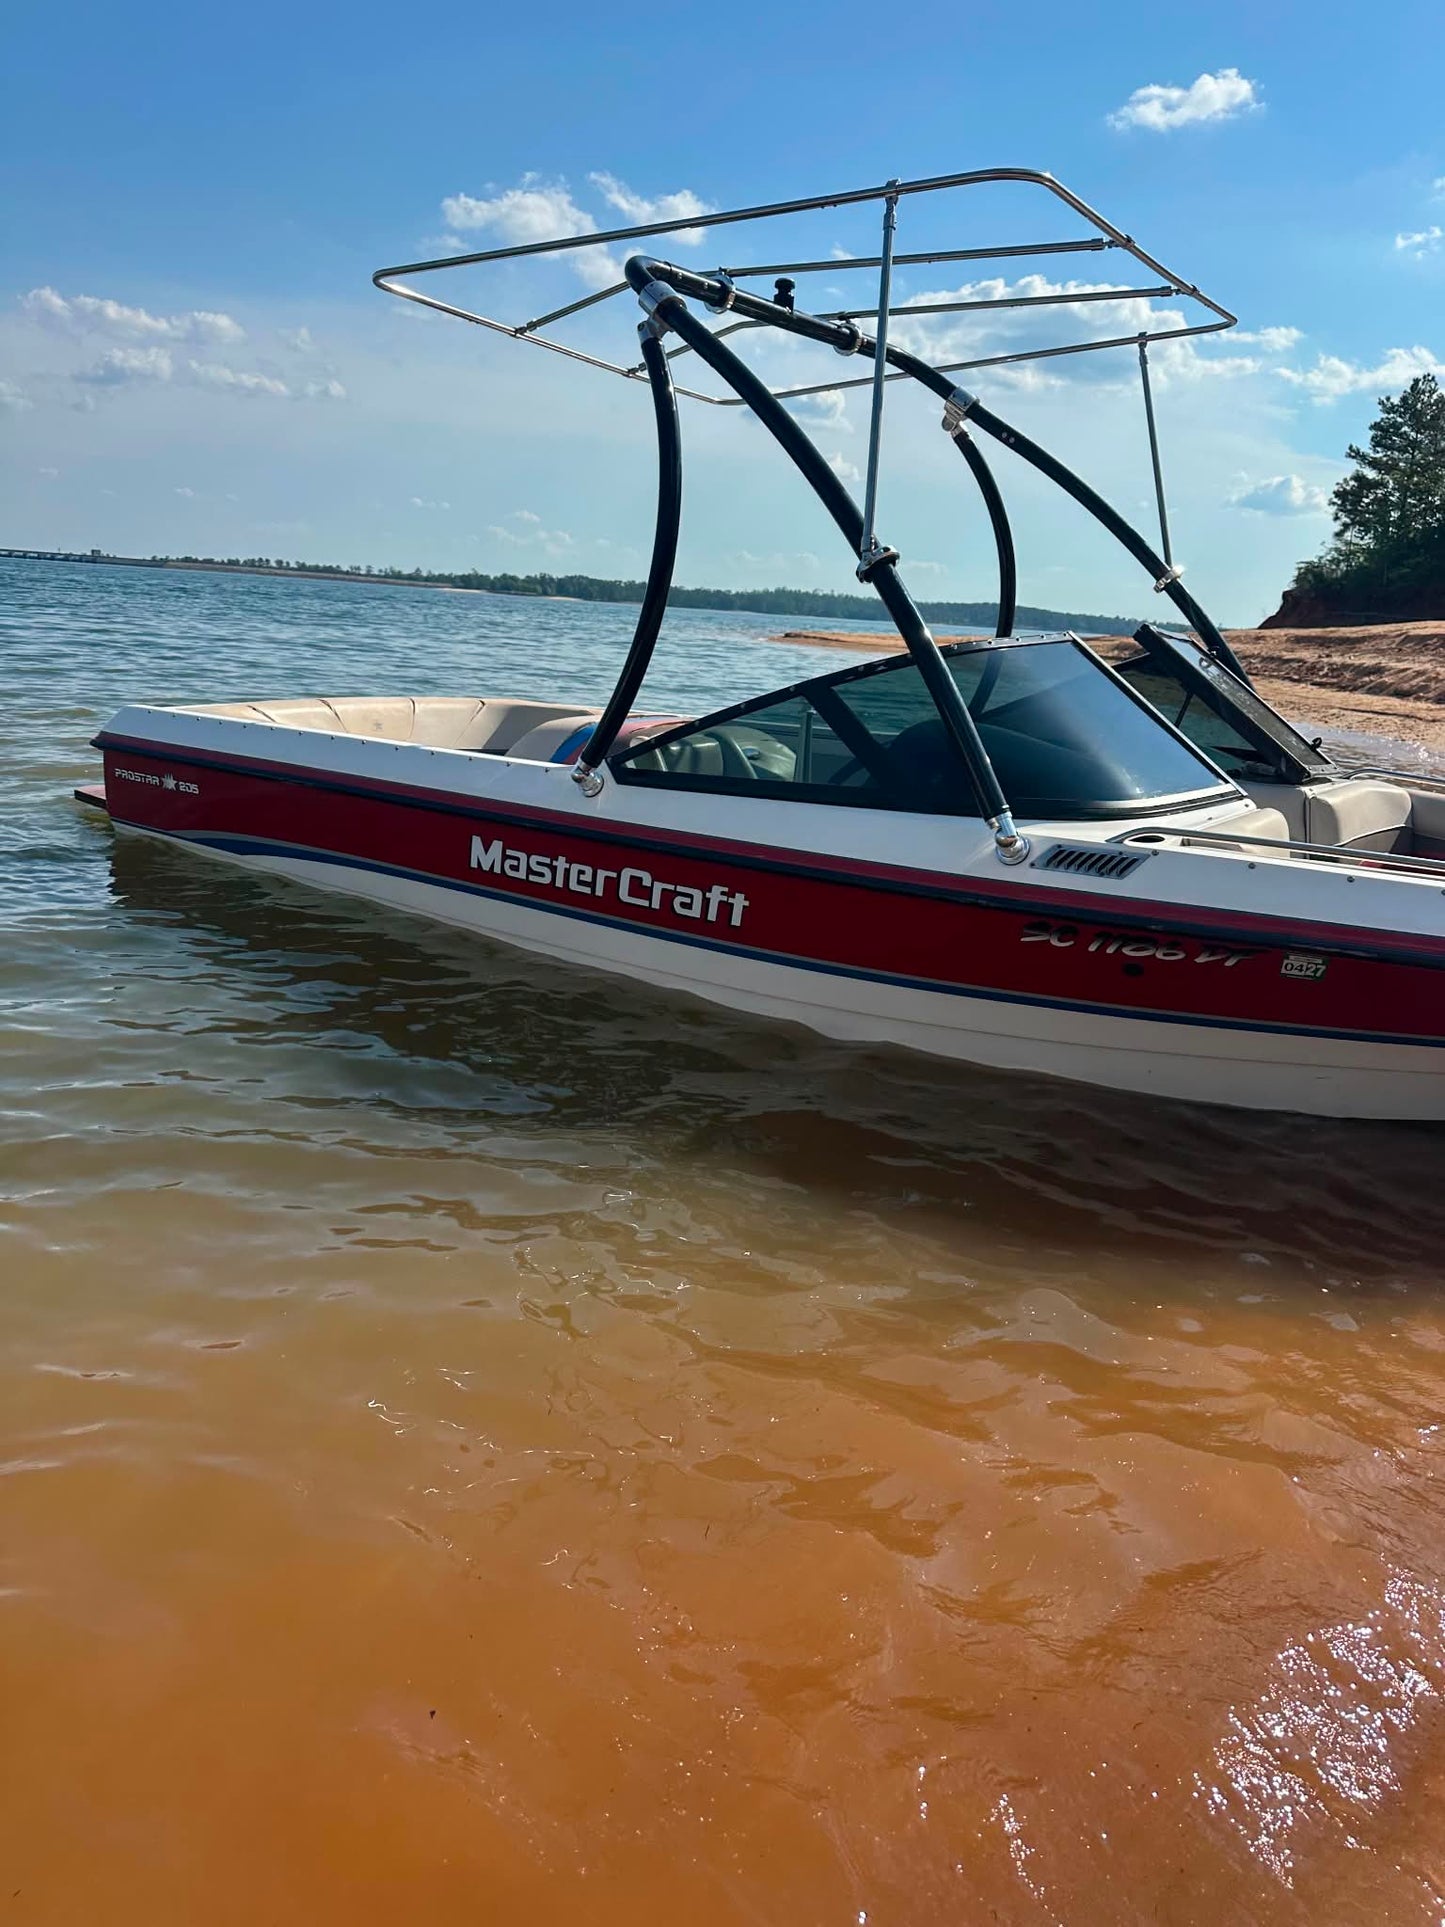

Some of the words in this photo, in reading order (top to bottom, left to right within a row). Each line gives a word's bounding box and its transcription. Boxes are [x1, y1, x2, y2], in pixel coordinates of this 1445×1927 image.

[114, 768, 160, 786] PROSTAR
[178, 781, 200, 795] 205
[470, 835, 750, 927] MasterCraft
[1020, 921, 1078, 948] SC
